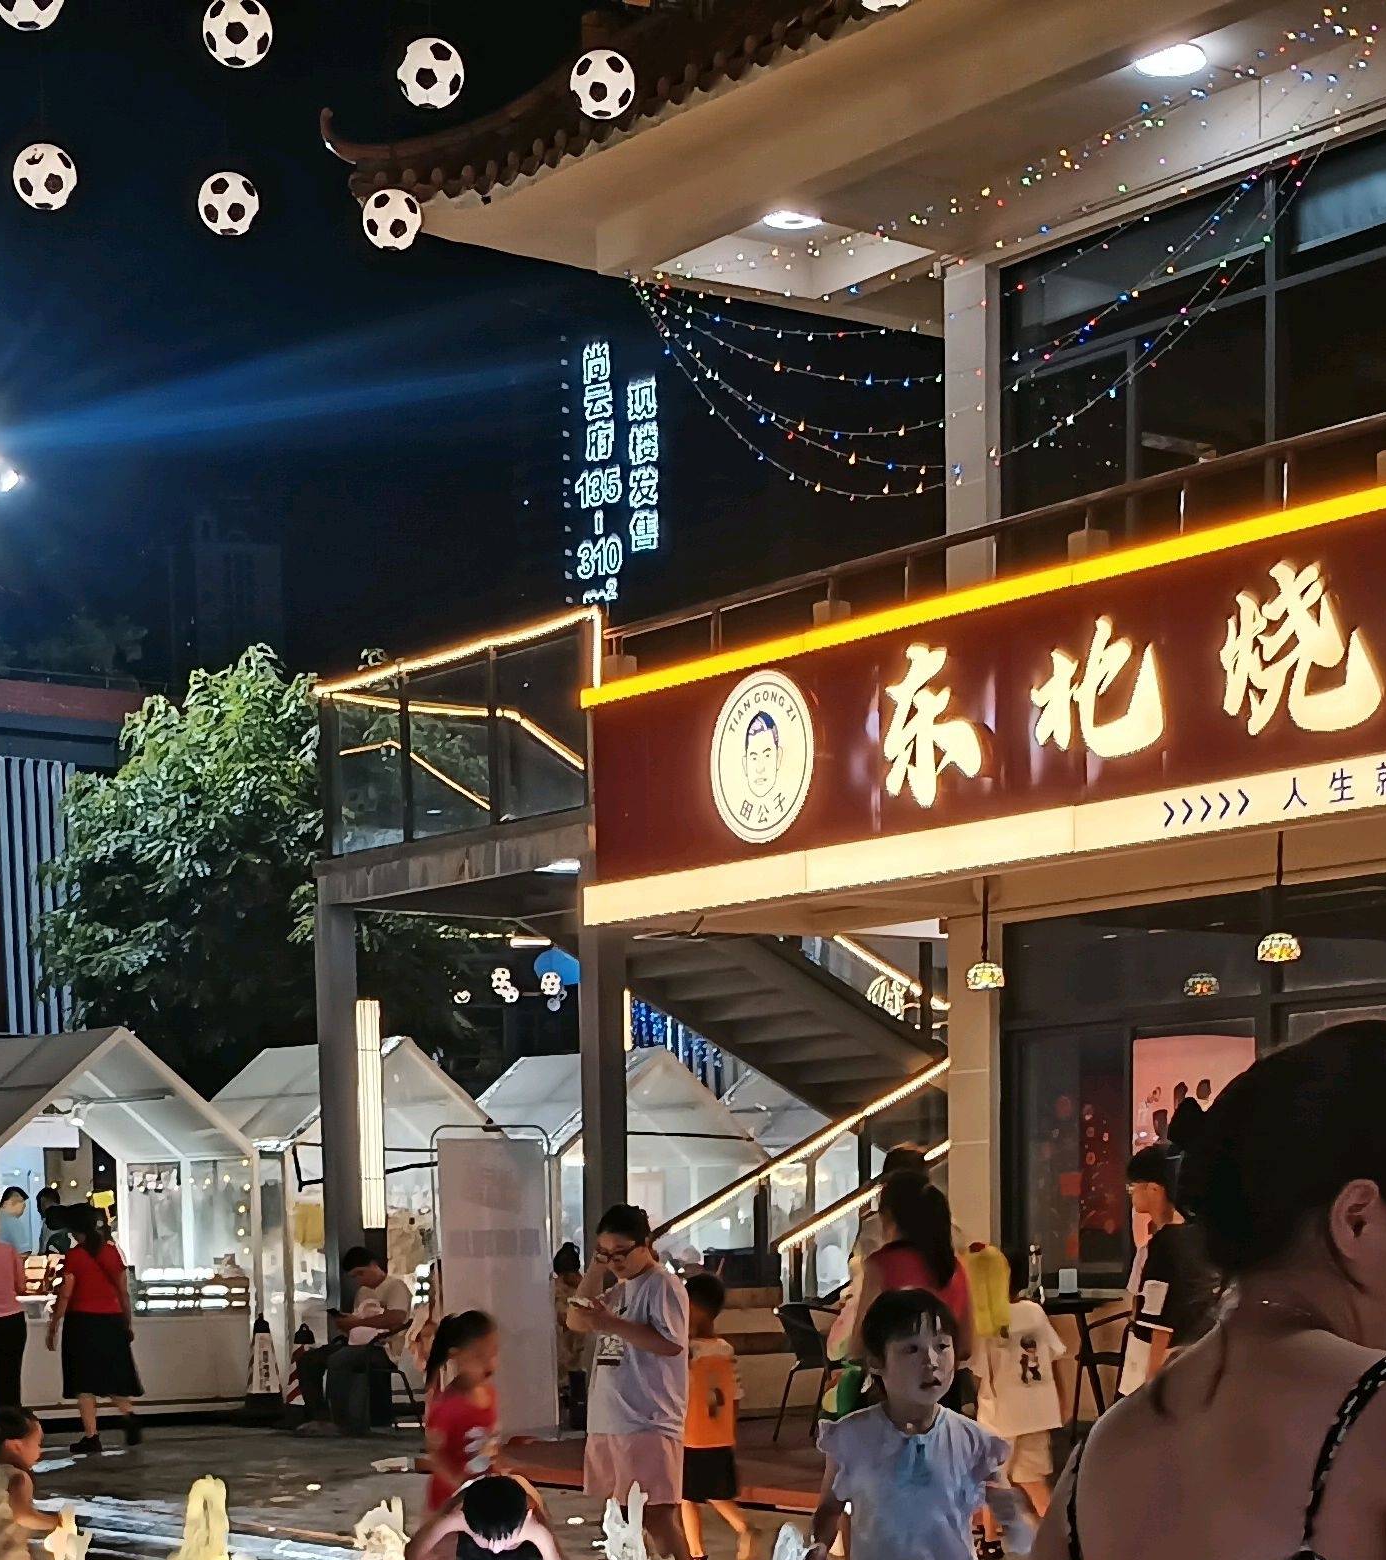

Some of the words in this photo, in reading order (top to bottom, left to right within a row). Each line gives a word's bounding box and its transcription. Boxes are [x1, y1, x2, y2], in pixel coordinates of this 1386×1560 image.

[627, 374, 659, 552] 现楼发售
[739, 791, 786, 823] 田公子
